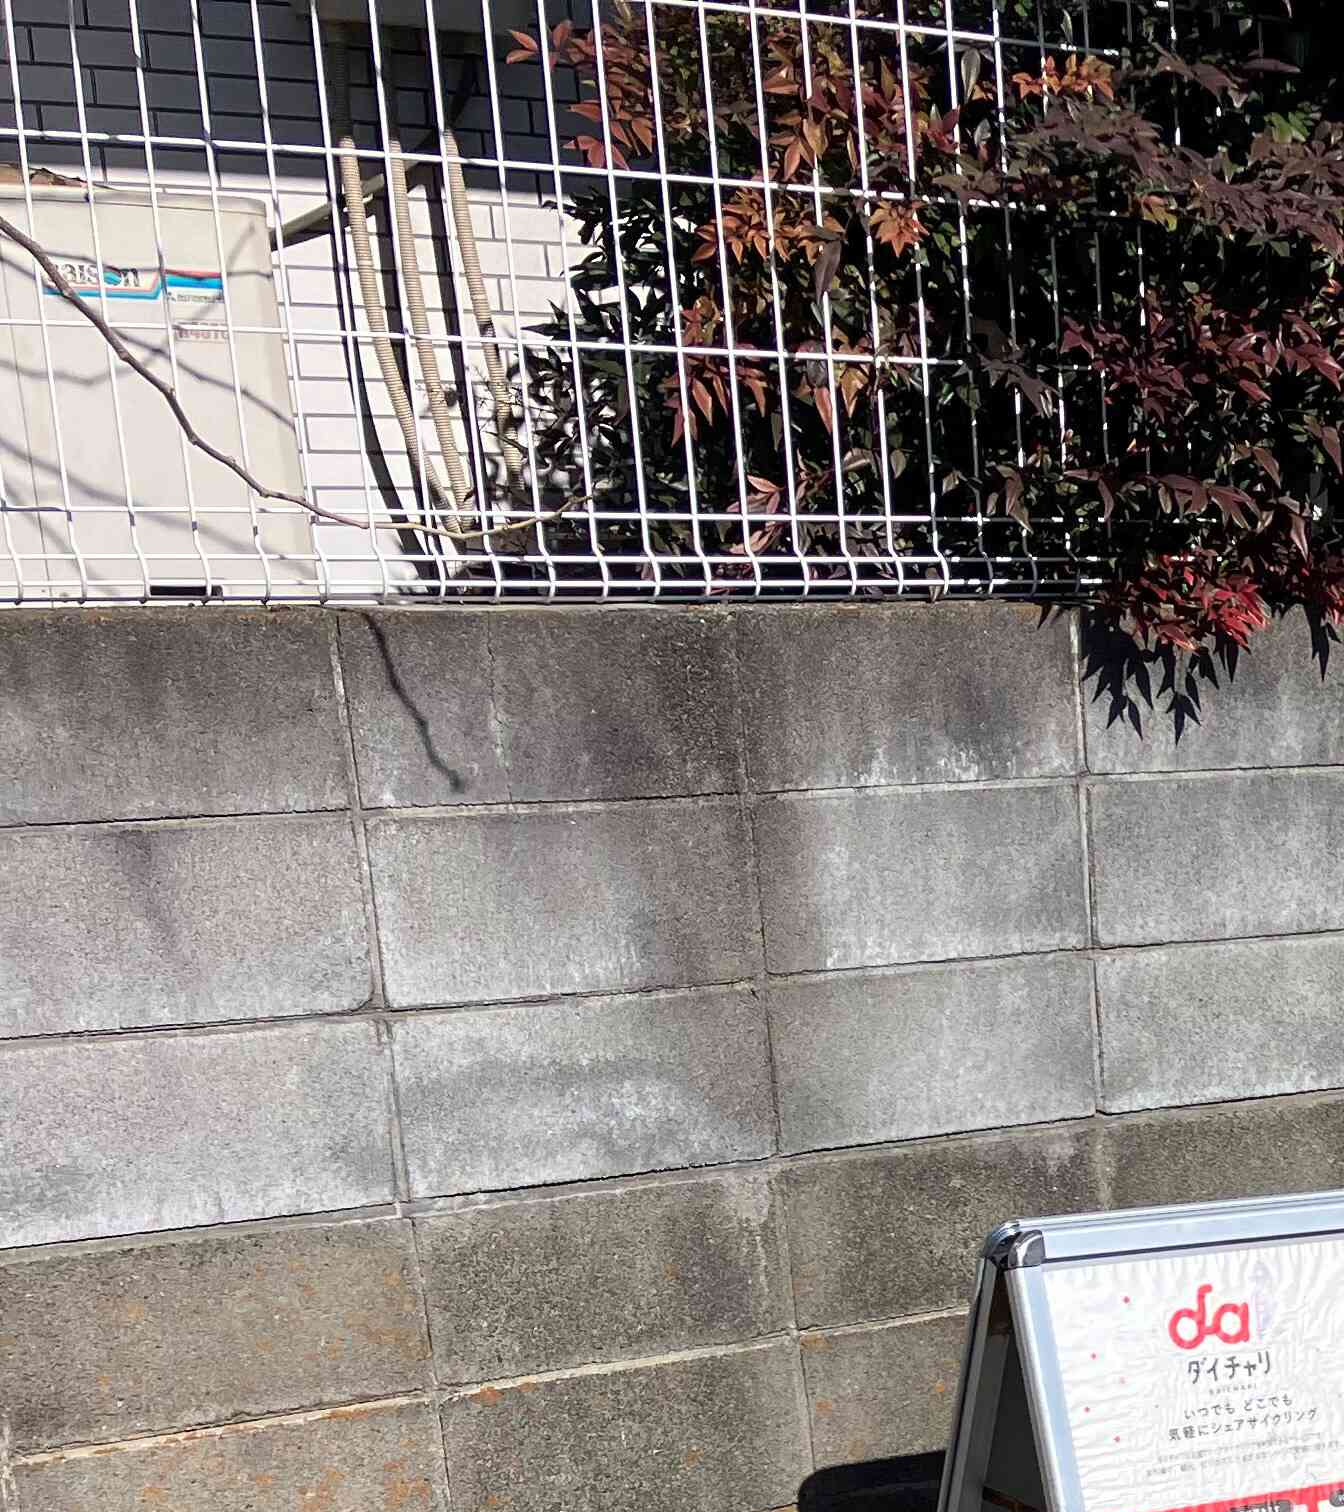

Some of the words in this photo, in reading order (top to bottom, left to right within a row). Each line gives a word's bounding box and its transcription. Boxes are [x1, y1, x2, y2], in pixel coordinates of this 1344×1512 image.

[1168, 1284, 1250, 1350] da
[1187, 1351, 1272, 1384] ダイチャリ
[1184, 1402, 1236, 1420] いつでも
[1243, 1394, 1293, 1412] どこでも
[1168, 1407, 1318, 1441] 気軽にシェアサイクリング
